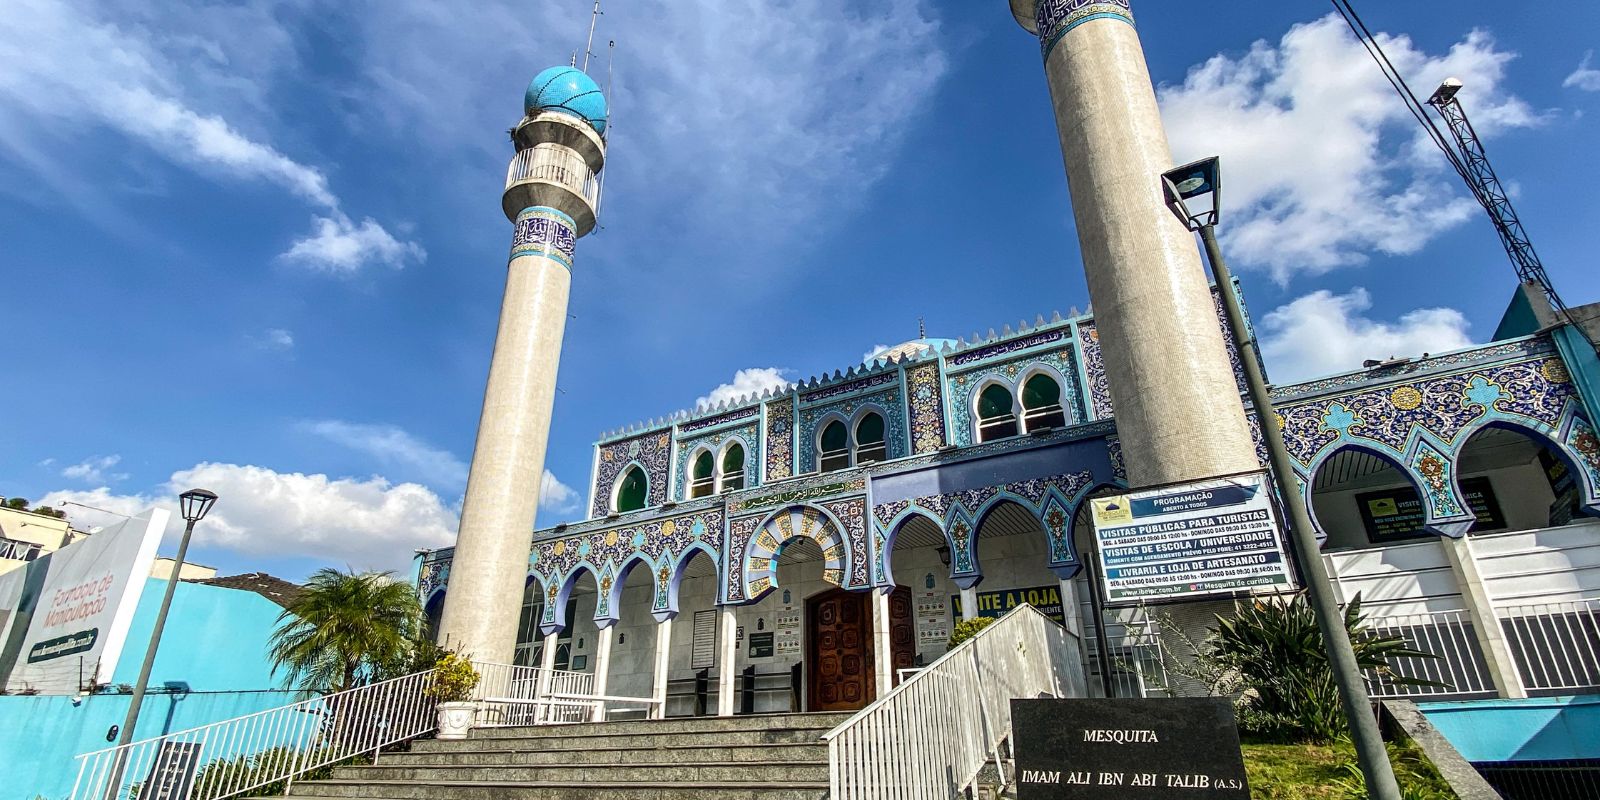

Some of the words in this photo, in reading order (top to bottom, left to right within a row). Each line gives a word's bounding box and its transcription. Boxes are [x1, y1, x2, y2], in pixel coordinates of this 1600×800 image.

[1153, 492, 1213, 507] PROGRAMAÇÃO
[1102, 528, 1137, 538] VISITAS
[1140, 521, 1187, 536] PÚBLICAS
[1189, 518, 1216, 528] PARA
[1217, 511, 1267, 524] TURISTAS
[1191, 529, 1214, 537] DOMINGO
[1105, 547, 1139, 557] VISITAS
[1142, 545, 1153, 554] DE
[1156, 542, 1192, 552] ESCOLA
[1200, 532, 1272, 547] UNIVERSIDADE
[1119, 567, 1158, 577] LIVRARIA
[1160, 566, 1167, 574] E
[1168, 563, 1191, 572] LOJA
[1192, 562, 1205, 570] DE
[1207, 555, 1266, 569] ARTESANATO
[1200, 571, 1225, 579] DOMINGO
[98, 570, 114, 592] de
[1204, 581, 1236, 590] Mesquita
[1247, 577, 1274, 586] curitiba
[1083, 729, 1159, 745] MESQUITA
[1021, 770, 1061, 784] IMAM
[1067, 772, 1091, 785] ALI
[1098, 772, 1124, 786] IBN
[1131, 773, 1157, 787] ABI
[1165, 774, 1210, 788] TALIB
[1214, 779, 1243, 790] (A.S.)
